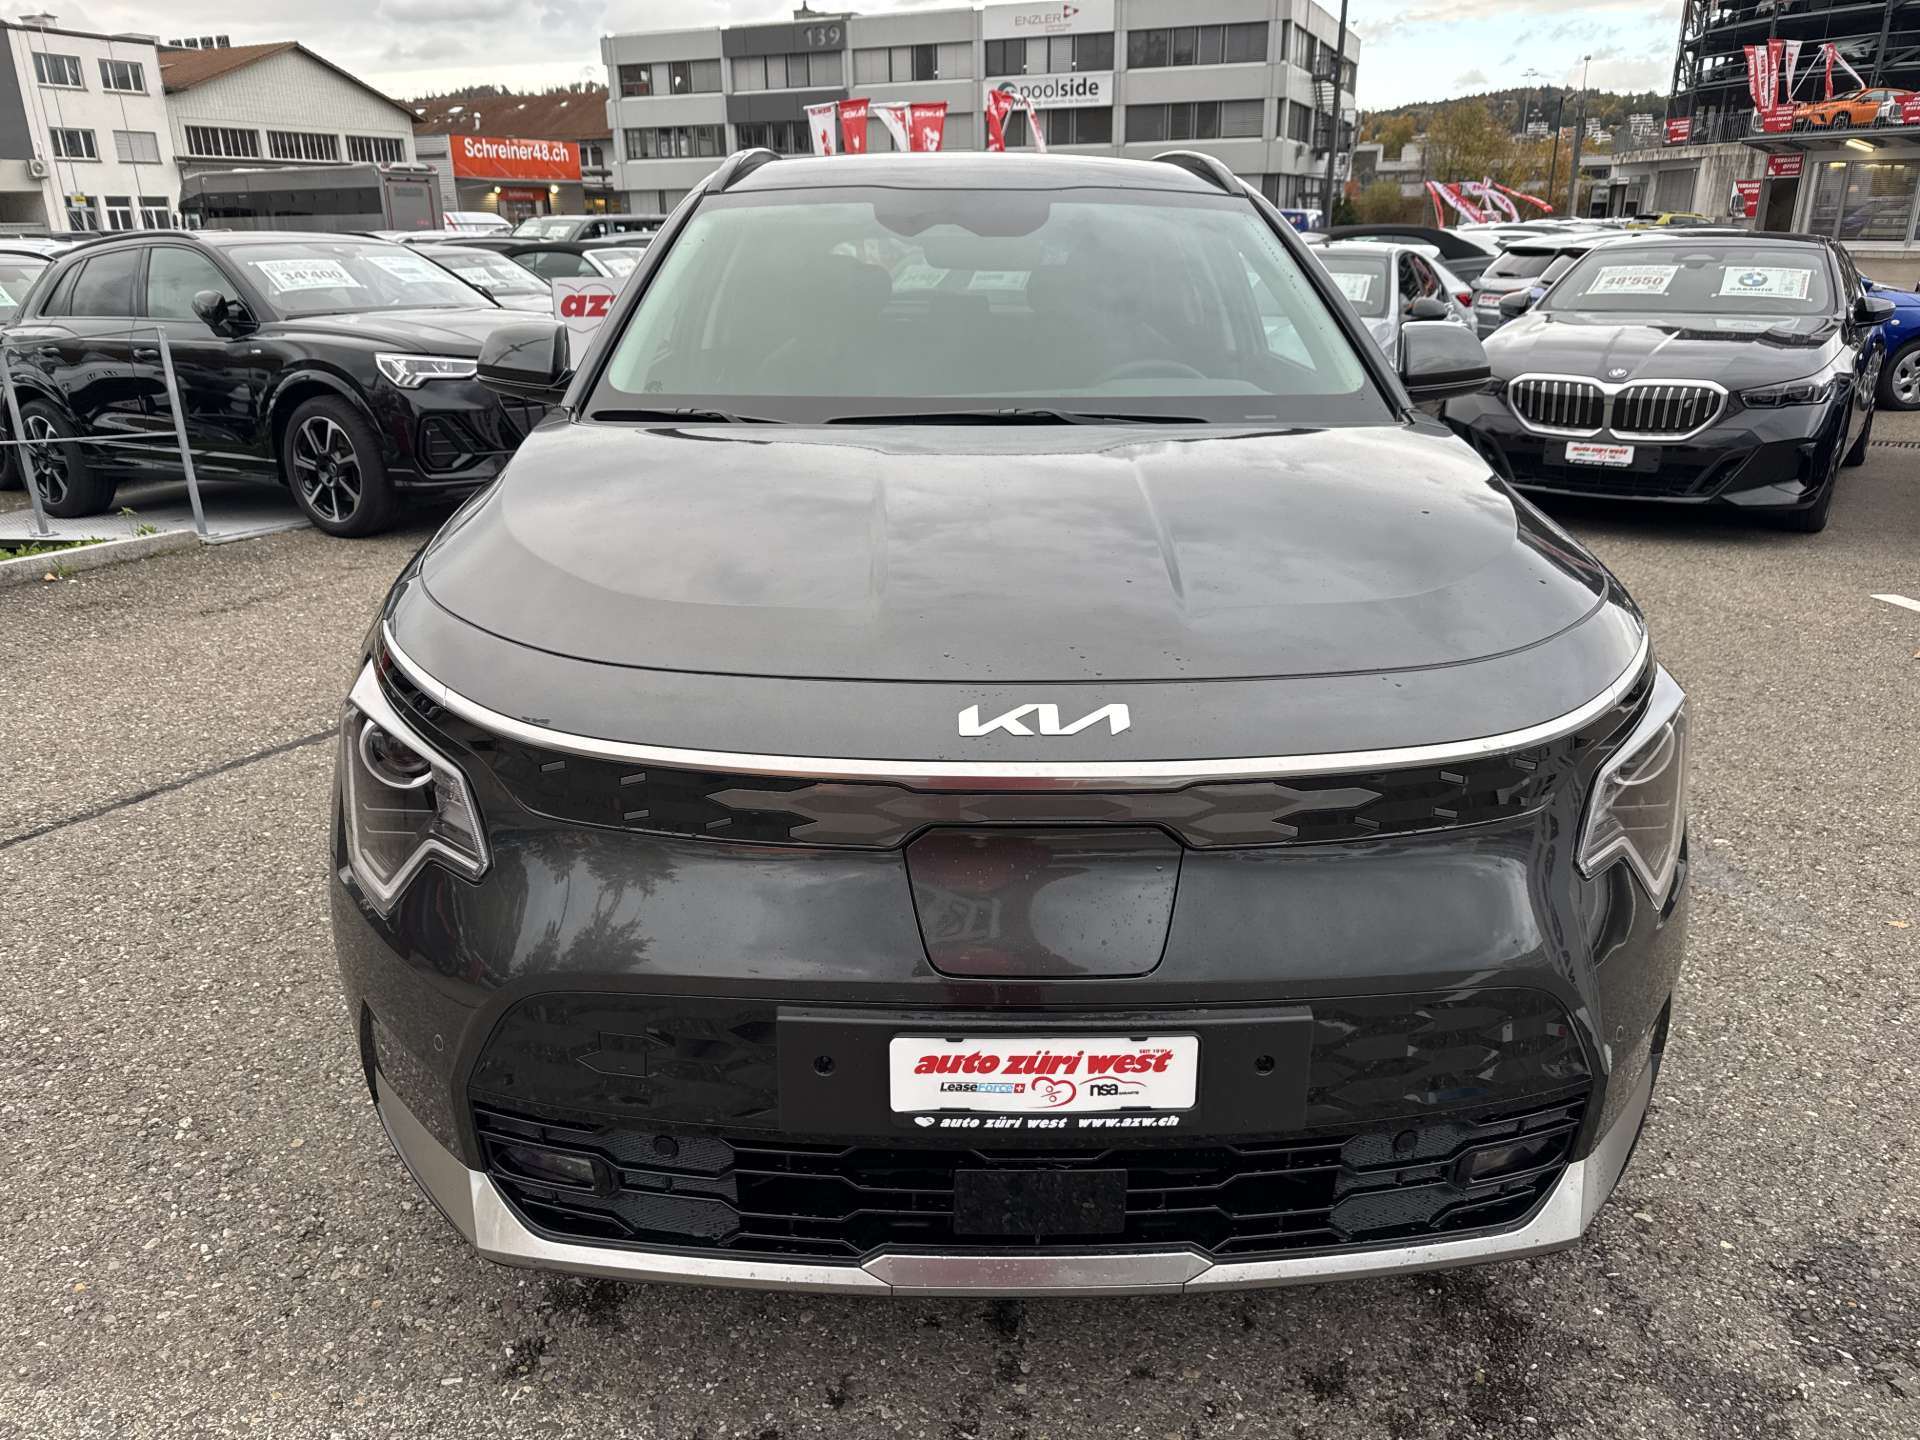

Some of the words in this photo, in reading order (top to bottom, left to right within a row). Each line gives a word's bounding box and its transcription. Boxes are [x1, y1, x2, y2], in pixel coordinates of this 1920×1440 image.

[1014, 13, 1062, 26] ENZLER
[803, 26, 841, 47] 139
[1020, 77, 1100, 99] poolside
[464, 137, 570, 162] Schreiner48.ch
[1605, 276, 1665, 286] 48'550
[958, 703, 1131, 736] KIA
[914, 1050, 1000, 1075] auto
[1000, 1050, 1085, 1075] züri
[1087, 1050, 1174, 1075] west
[940, 1082, 1014, 1093] LeaseForce
[1090, 1083, 1119, 1096] nsa
[940, 1117, 980, 1128] auto
[984, 1116, 1023, 1128] züri
[1027, 1117, 1067, 1128] west
[1078, 1115, 1180, 1128] www.azw.ch
